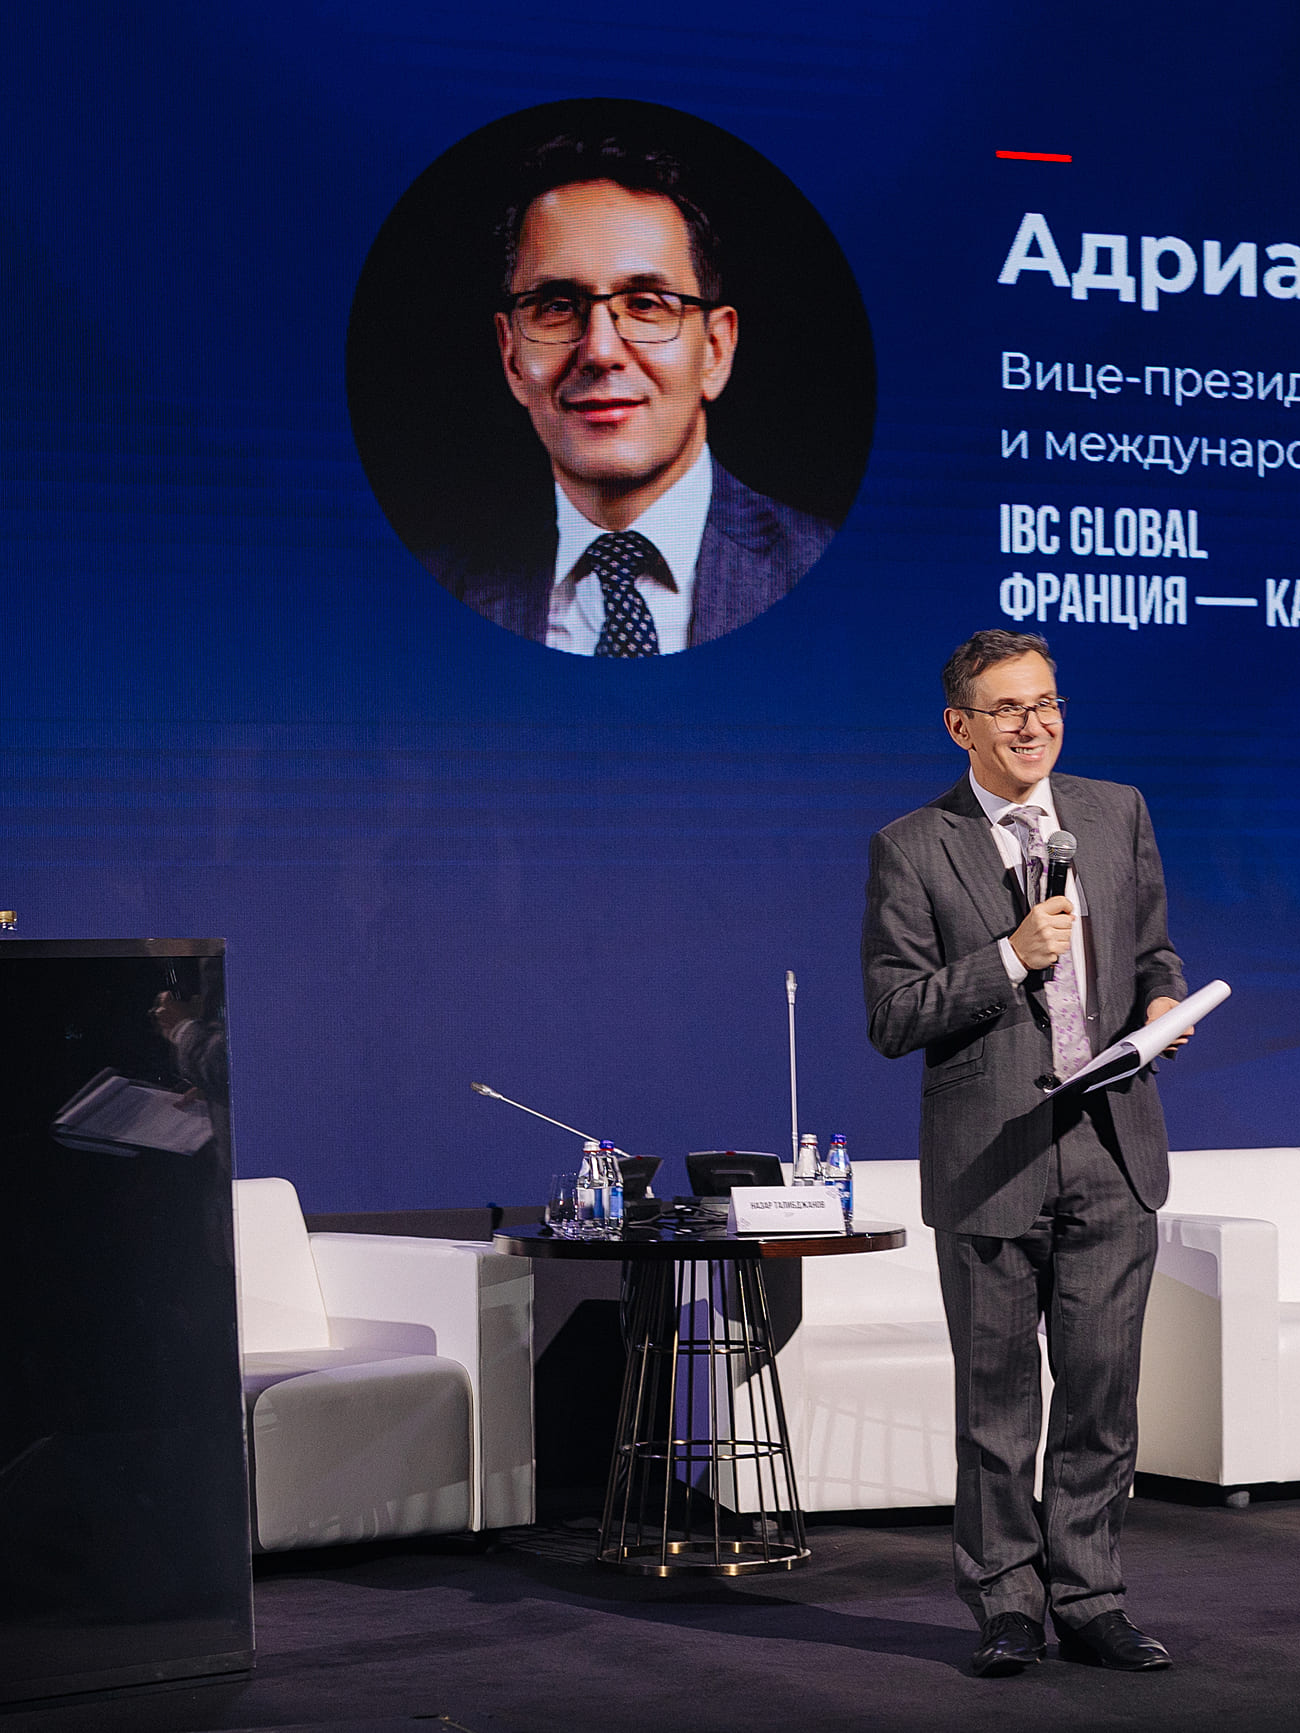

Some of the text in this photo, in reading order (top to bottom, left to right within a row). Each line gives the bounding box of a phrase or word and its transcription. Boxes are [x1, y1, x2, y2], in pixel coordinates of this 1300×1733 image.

[1000, 430, 1029, 460] и
[1000, 503, 1209, 560] IBC GLOBAL
[999, 571, 1189, 631] ФРАНЦИЯ
